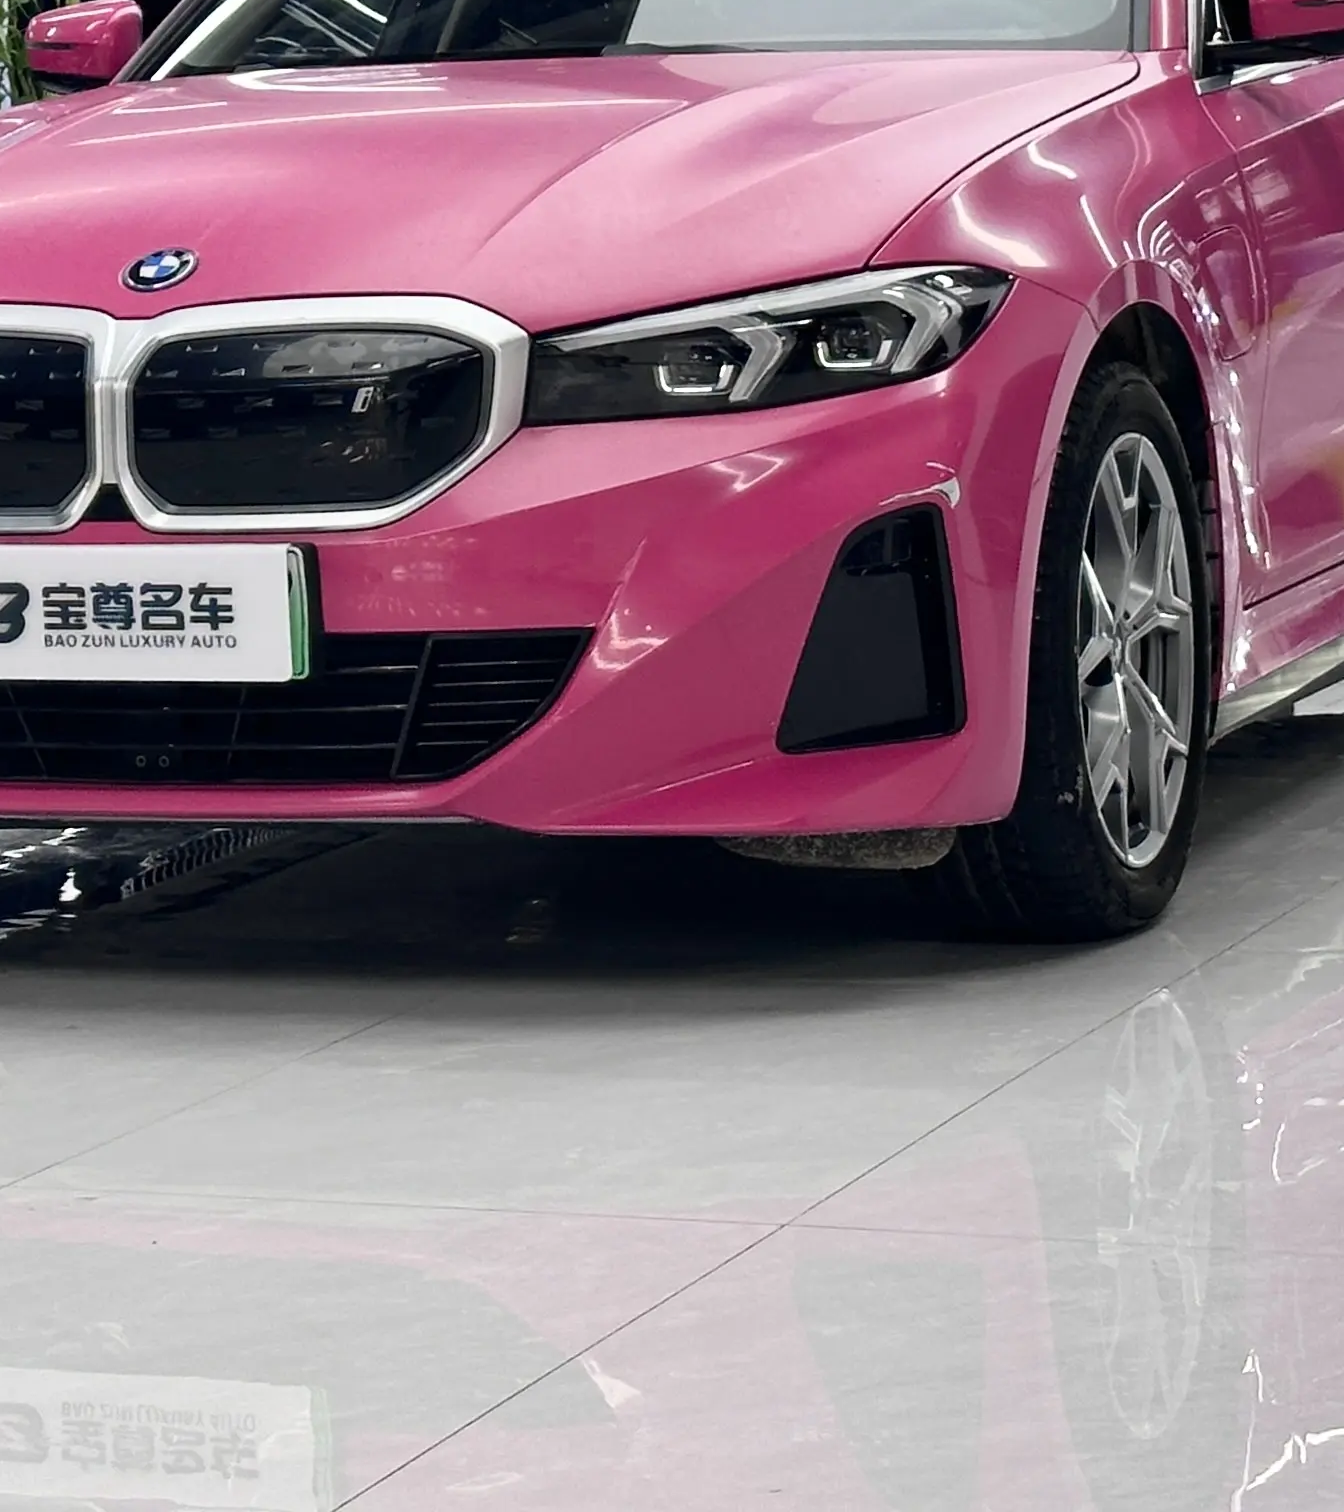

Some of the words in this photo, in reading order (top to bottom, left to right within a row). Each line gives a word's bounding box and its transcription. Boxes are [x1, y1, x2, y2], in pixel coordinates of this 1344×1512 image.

[42, 583, 234, 631] 宝尊名车
[44, 635, 77, 648] BAO
[81, 635, 116, 648] ZUN
[120, 635, 186, 648] LUXURY
[191, 635, 237, 649] AUTO
